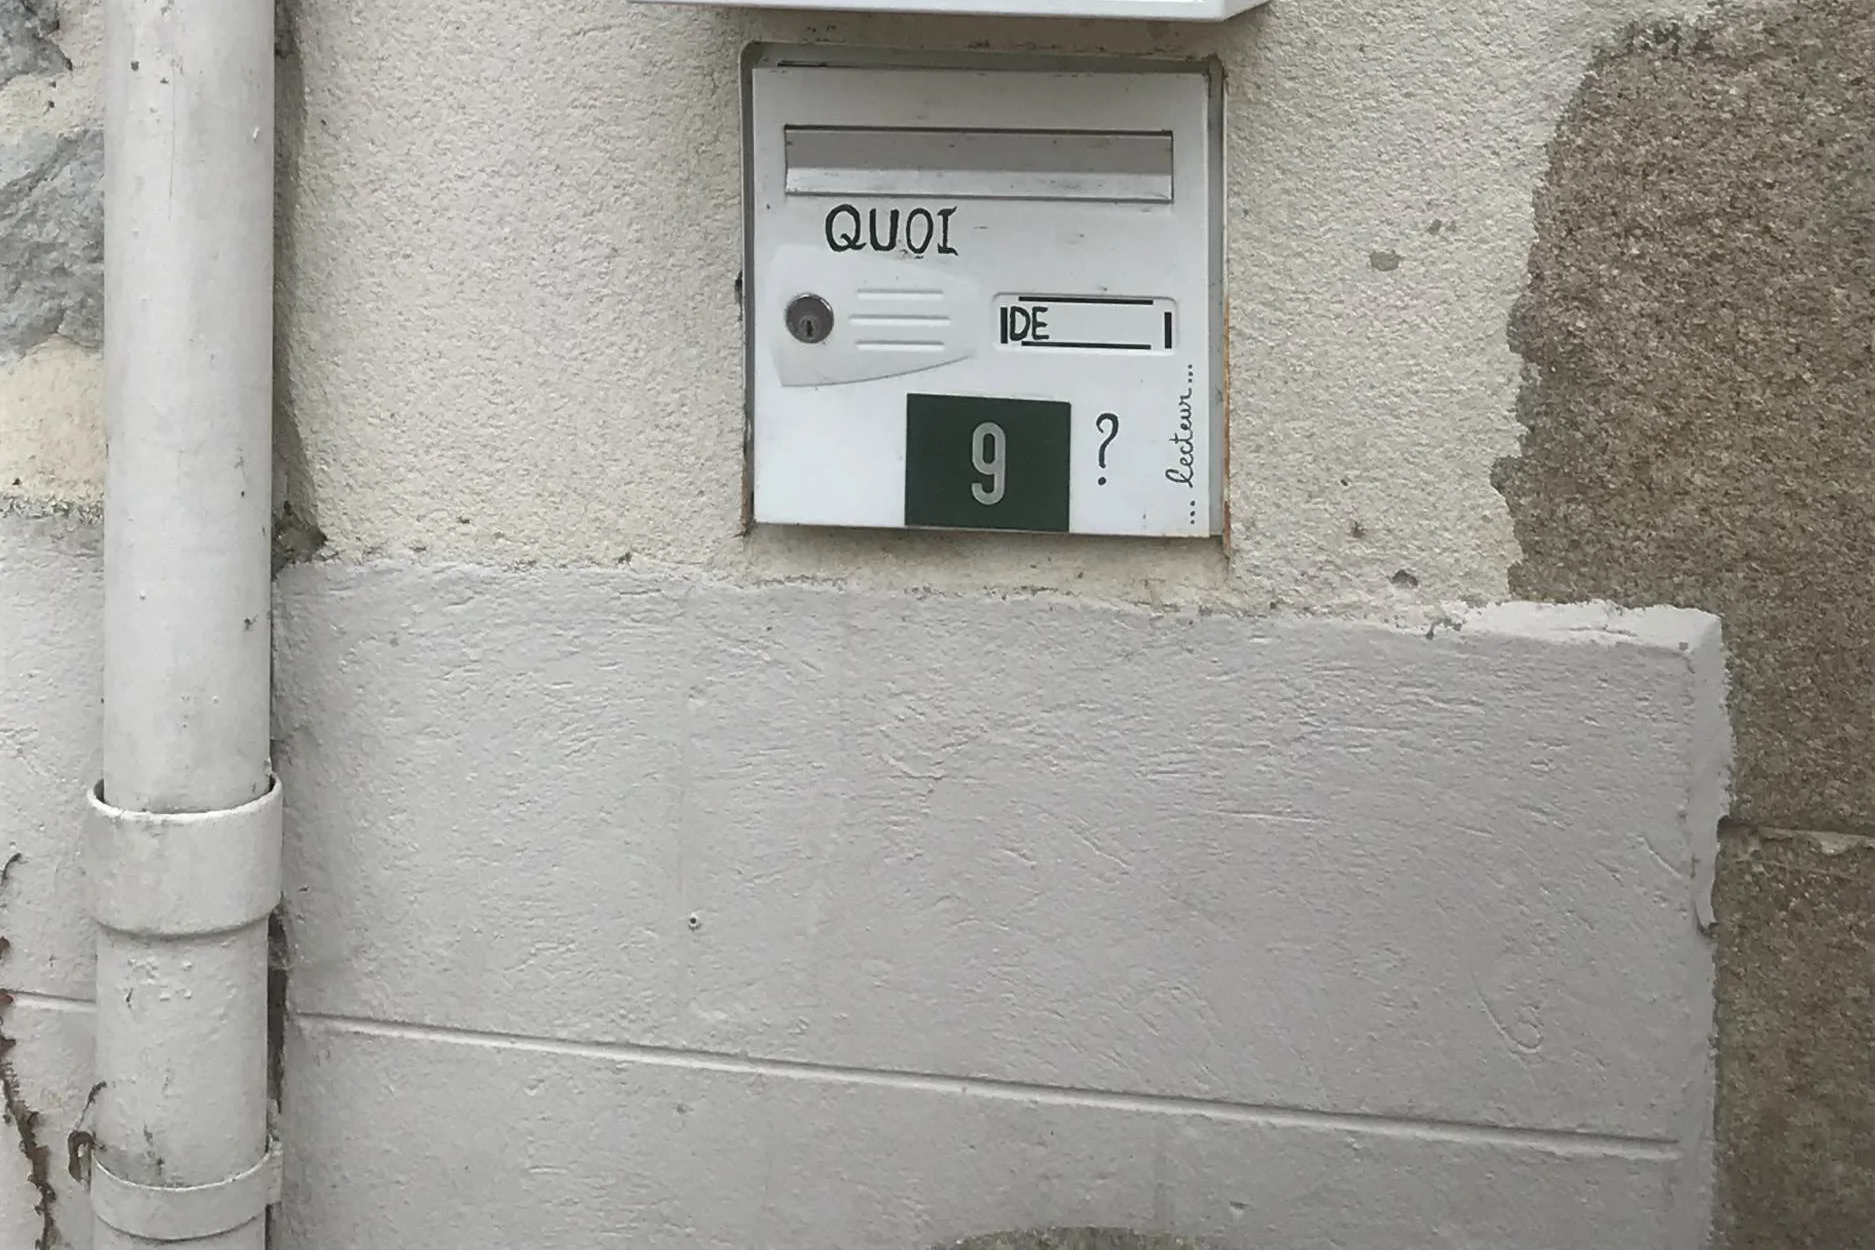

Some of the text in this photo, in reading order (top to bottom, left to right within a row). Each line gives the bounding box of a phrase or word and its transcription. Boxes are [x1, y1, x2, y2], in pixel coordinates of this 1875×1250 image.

[825, 204, 958, 257] QUOI
[971, 422, 1007, 506] 9
[1095, 412, 1119, 486] ?
